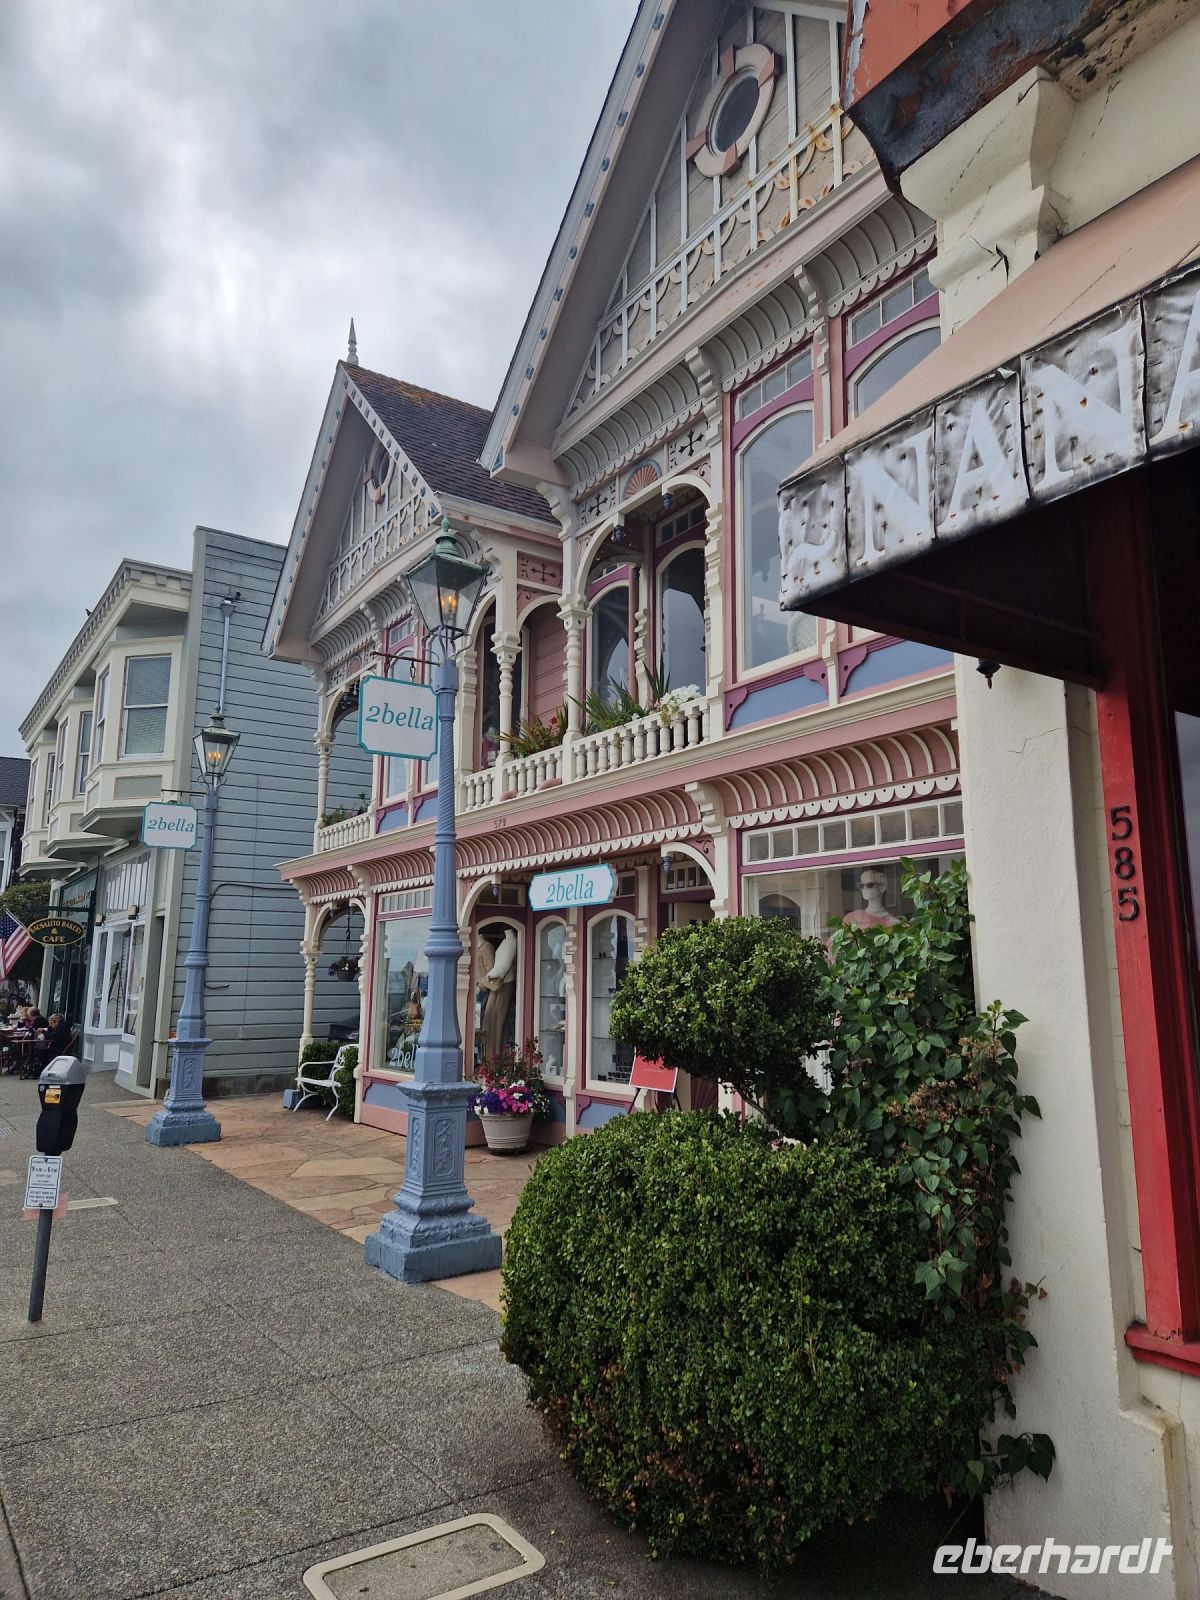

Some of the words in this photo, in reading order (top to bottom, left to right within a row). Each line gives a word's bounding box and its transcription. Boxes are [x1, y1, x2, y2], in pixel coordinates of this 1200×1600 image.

[365, 703, 434, 731] 2bella
[147, 817, 195, 833] 2bella
[1106, 805, 1140, 922] 585
[546, 873, 595, 904] 2bella
[29, 920, 61, 934] SAUSALITO
[61, 921, 83, 935] BAKERY
